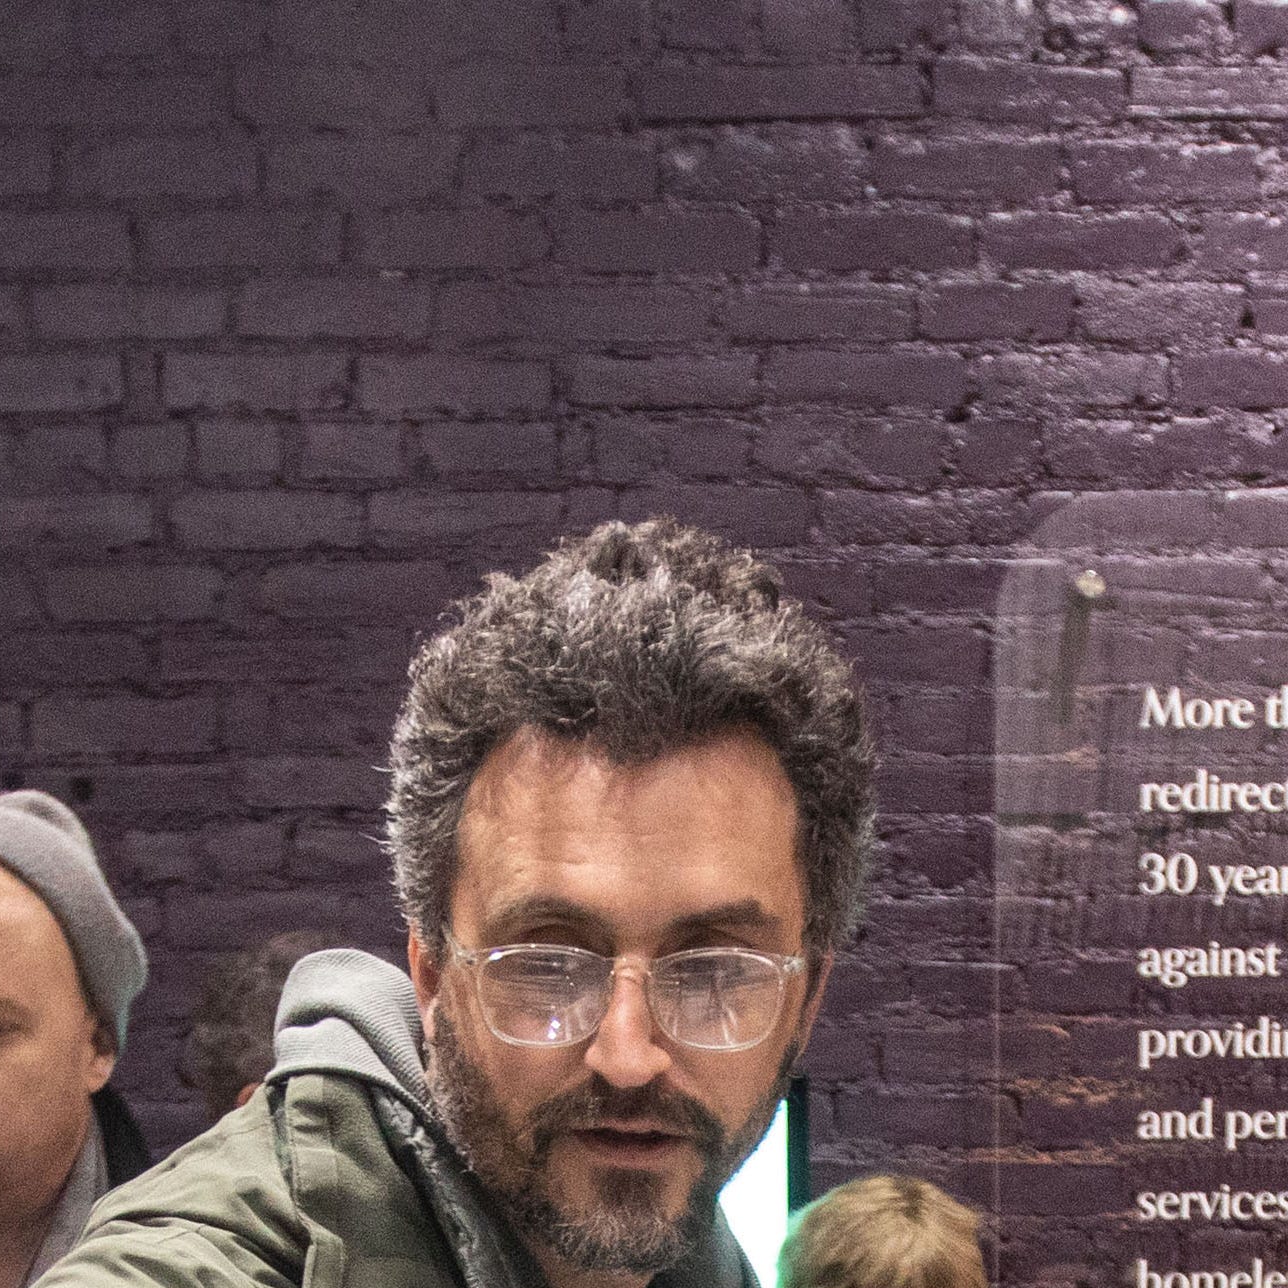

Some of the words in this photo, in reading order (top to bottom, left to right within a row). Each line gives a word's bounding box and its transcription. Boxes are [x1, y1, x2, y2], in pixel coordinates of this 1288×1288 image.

[1139, 686, 1254, 730] More
[1138, 852, 1198, 896] 30
[1137, 940, 1281, 989] against
[1137, 1097, 1213, 1140] and
